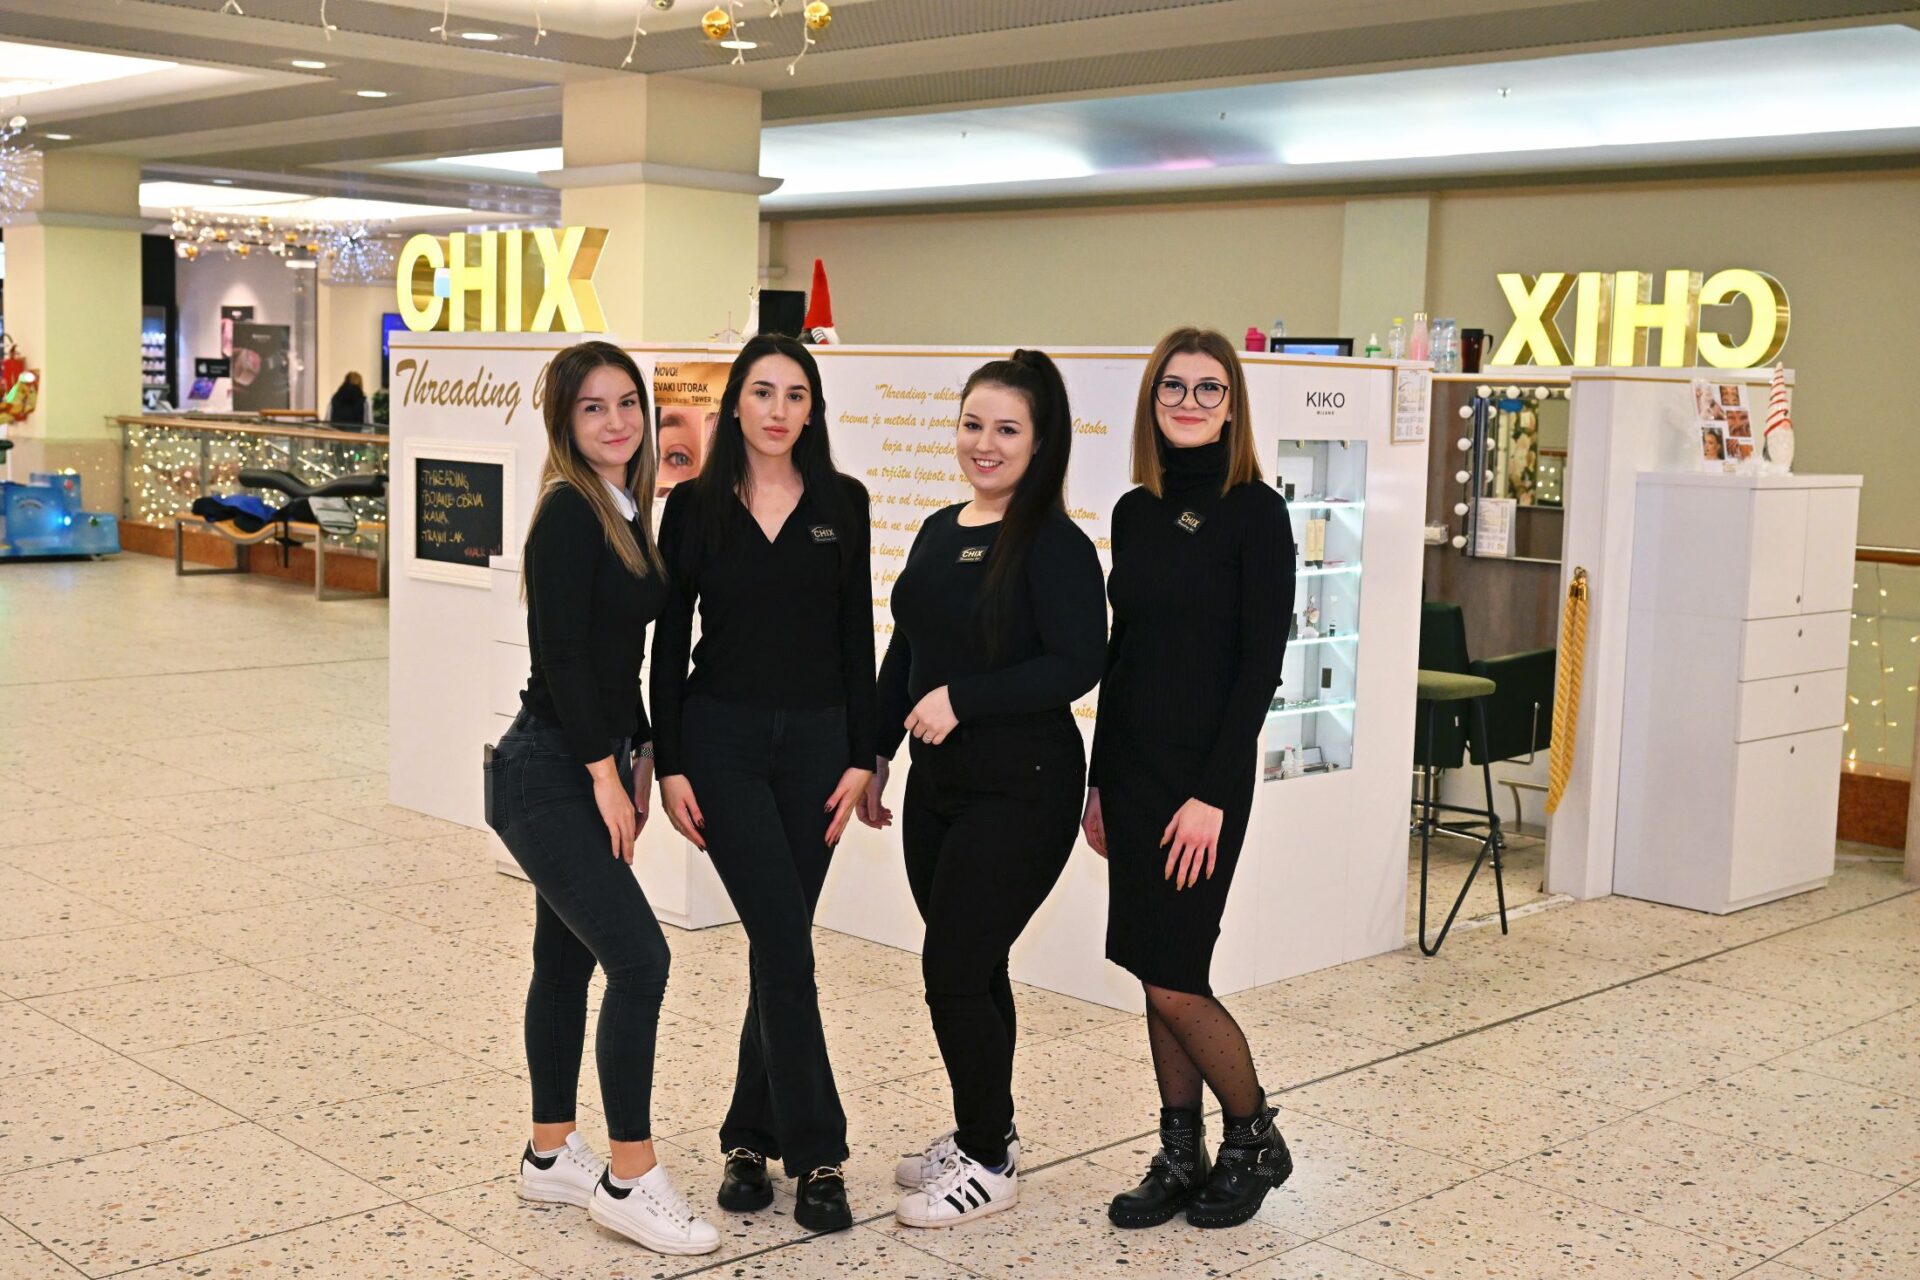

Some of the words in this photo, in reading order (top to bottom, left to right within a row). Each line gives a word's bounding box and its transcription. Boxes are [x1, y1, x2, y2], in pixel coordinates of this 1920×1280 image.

[397, 226, 592, 333] CHIX
[655, 366, 679, 377] NOVO!
[396, 358, 521, 425] Threading
[653, 382, 675, 392] SVAKI
[677, 382, 708, 393] UTORAK
[1306, 391, 1345, 408] KIKO
[871, 413, 881, 428] je
[884, 413, 917, 426] metoda
[920, 417, 925, 426] s
[1072, 416, 1108, 434] Istoka
[881, 438, 902, 455] koja
[905, 444, 912, 452] u
[866, 468, 878, 477] na
[887, 495, 896, 504] se
[899, 493, 911, 505] od
[1181, 513, 1200, 528] CHIX
[813, 528, 835, 537] CHIX
[962, 550, 984, 558] CHIX
